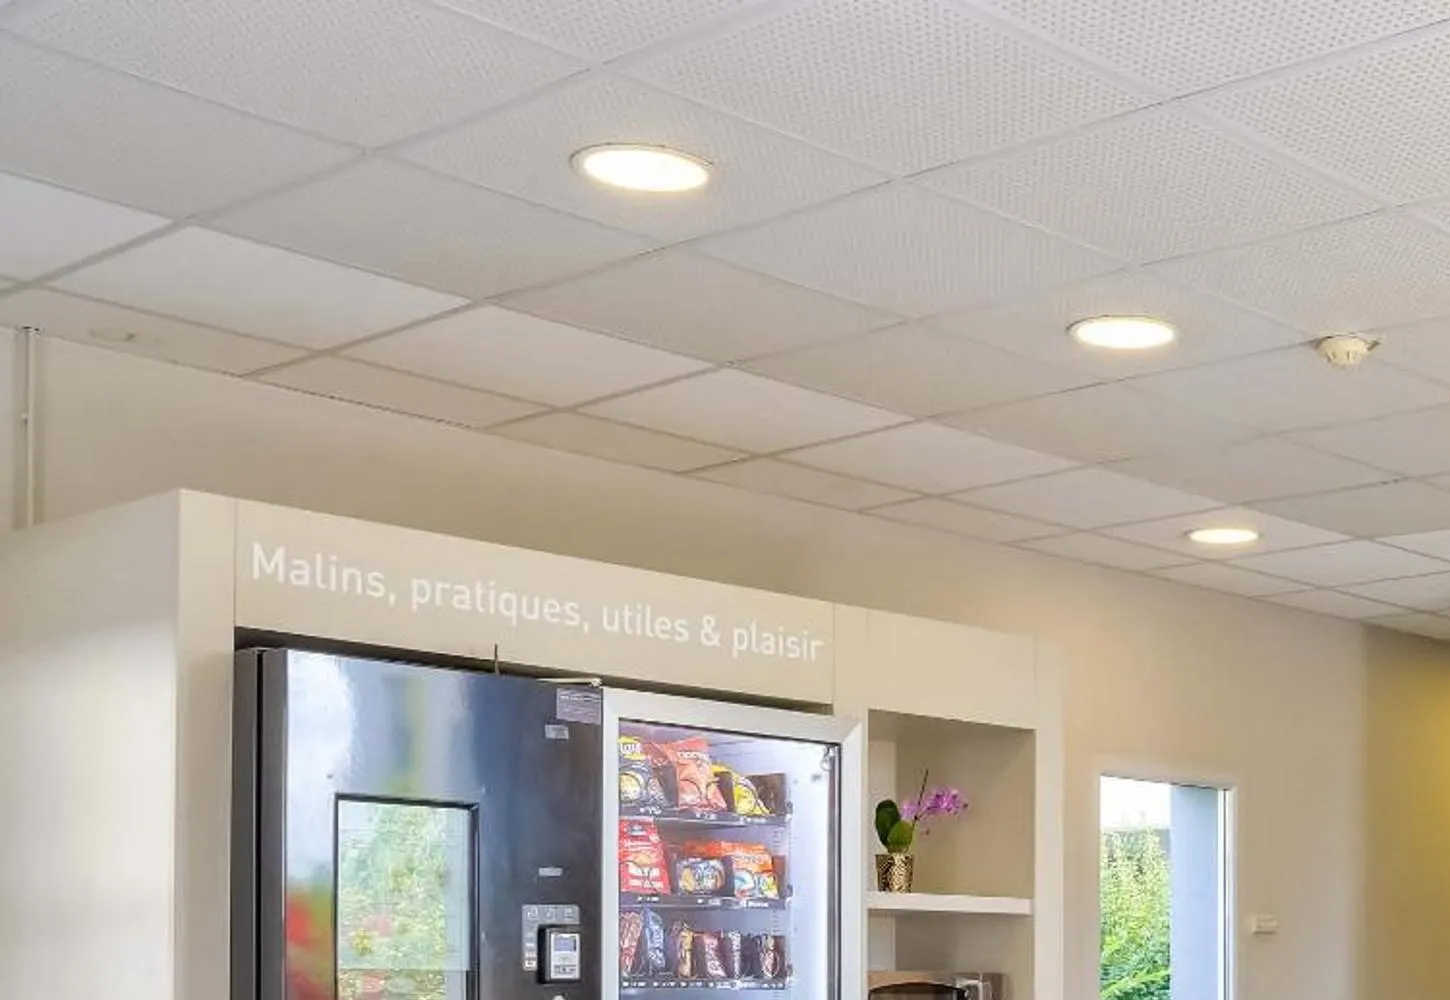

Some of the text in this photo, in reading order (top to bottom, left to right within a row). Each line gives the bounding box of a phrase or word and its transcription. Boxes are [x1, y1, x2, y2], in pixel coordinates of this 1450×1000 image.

[252, 542, 824, 662] Malins, pratiques, utiles & plaisir
